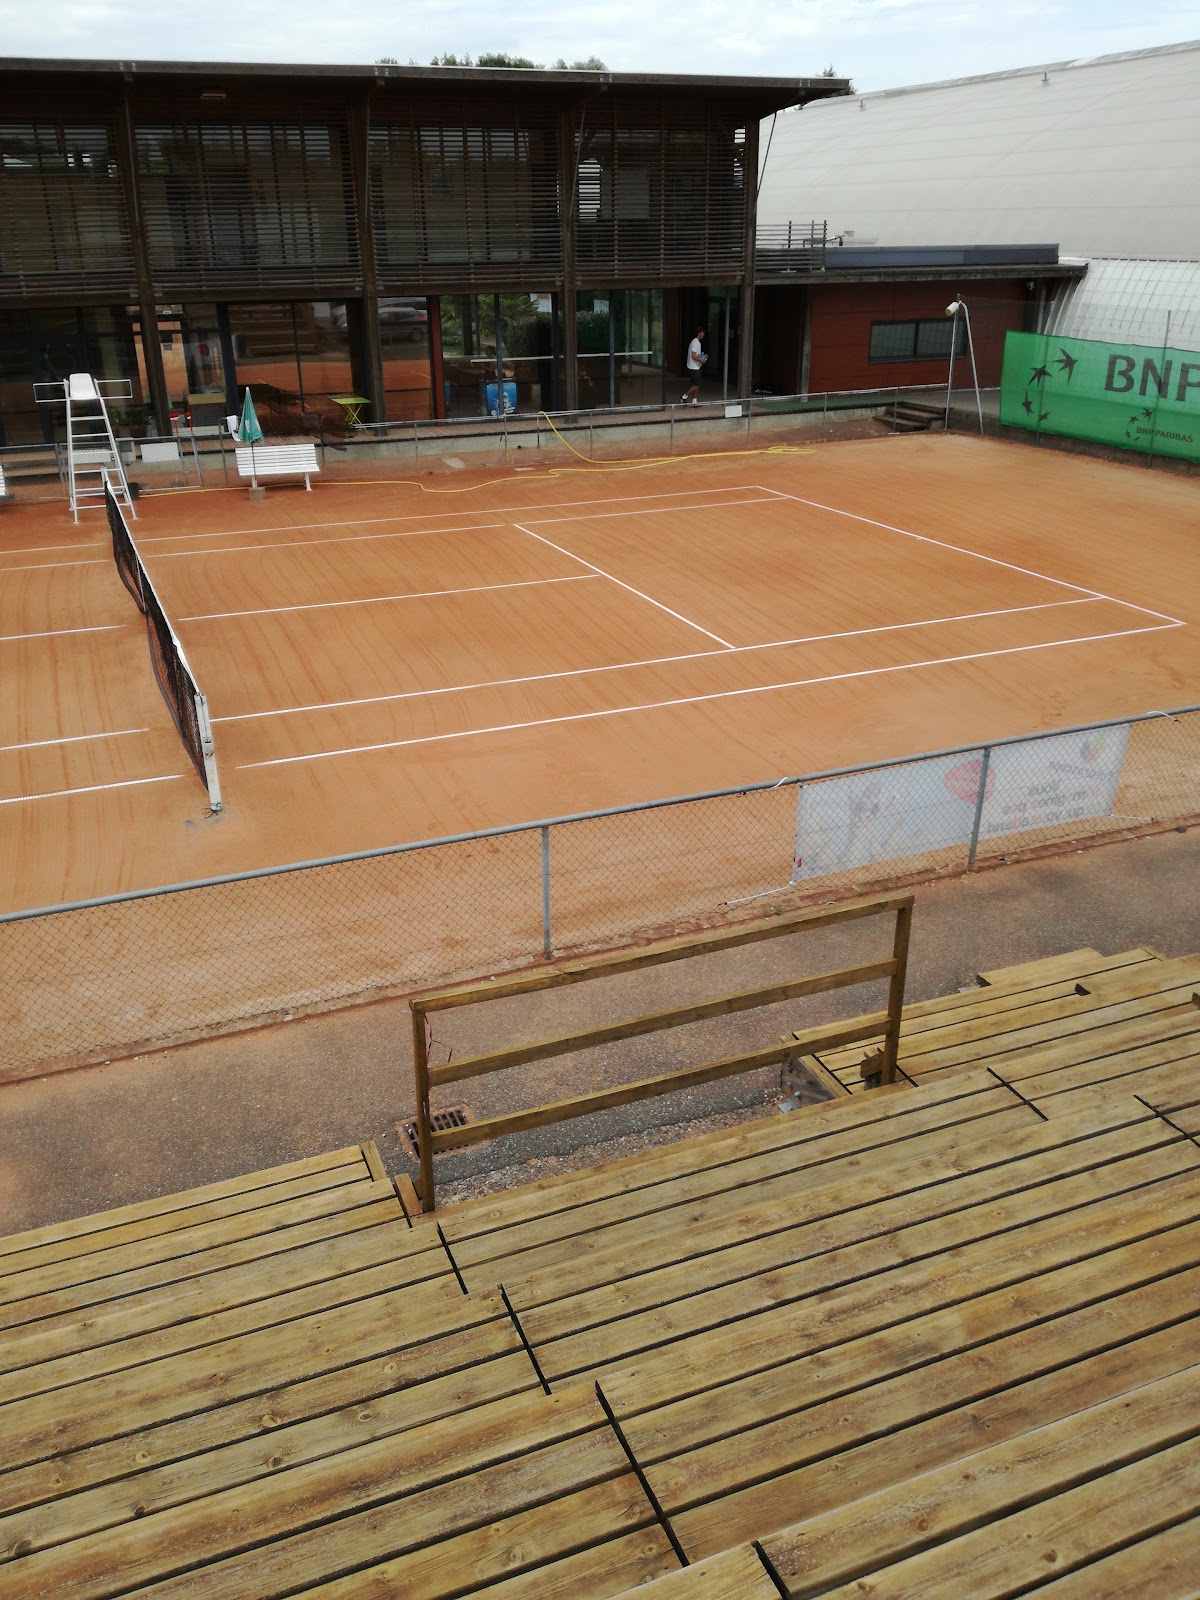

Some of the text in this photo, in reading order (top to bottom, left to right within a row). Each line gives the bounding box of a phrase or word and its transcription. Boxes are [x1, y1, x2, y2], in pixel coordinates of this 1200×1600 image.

[1104, 354, 1200, 402] BNP
[1136, 426, 1193, 443] BNP PARIBAS
